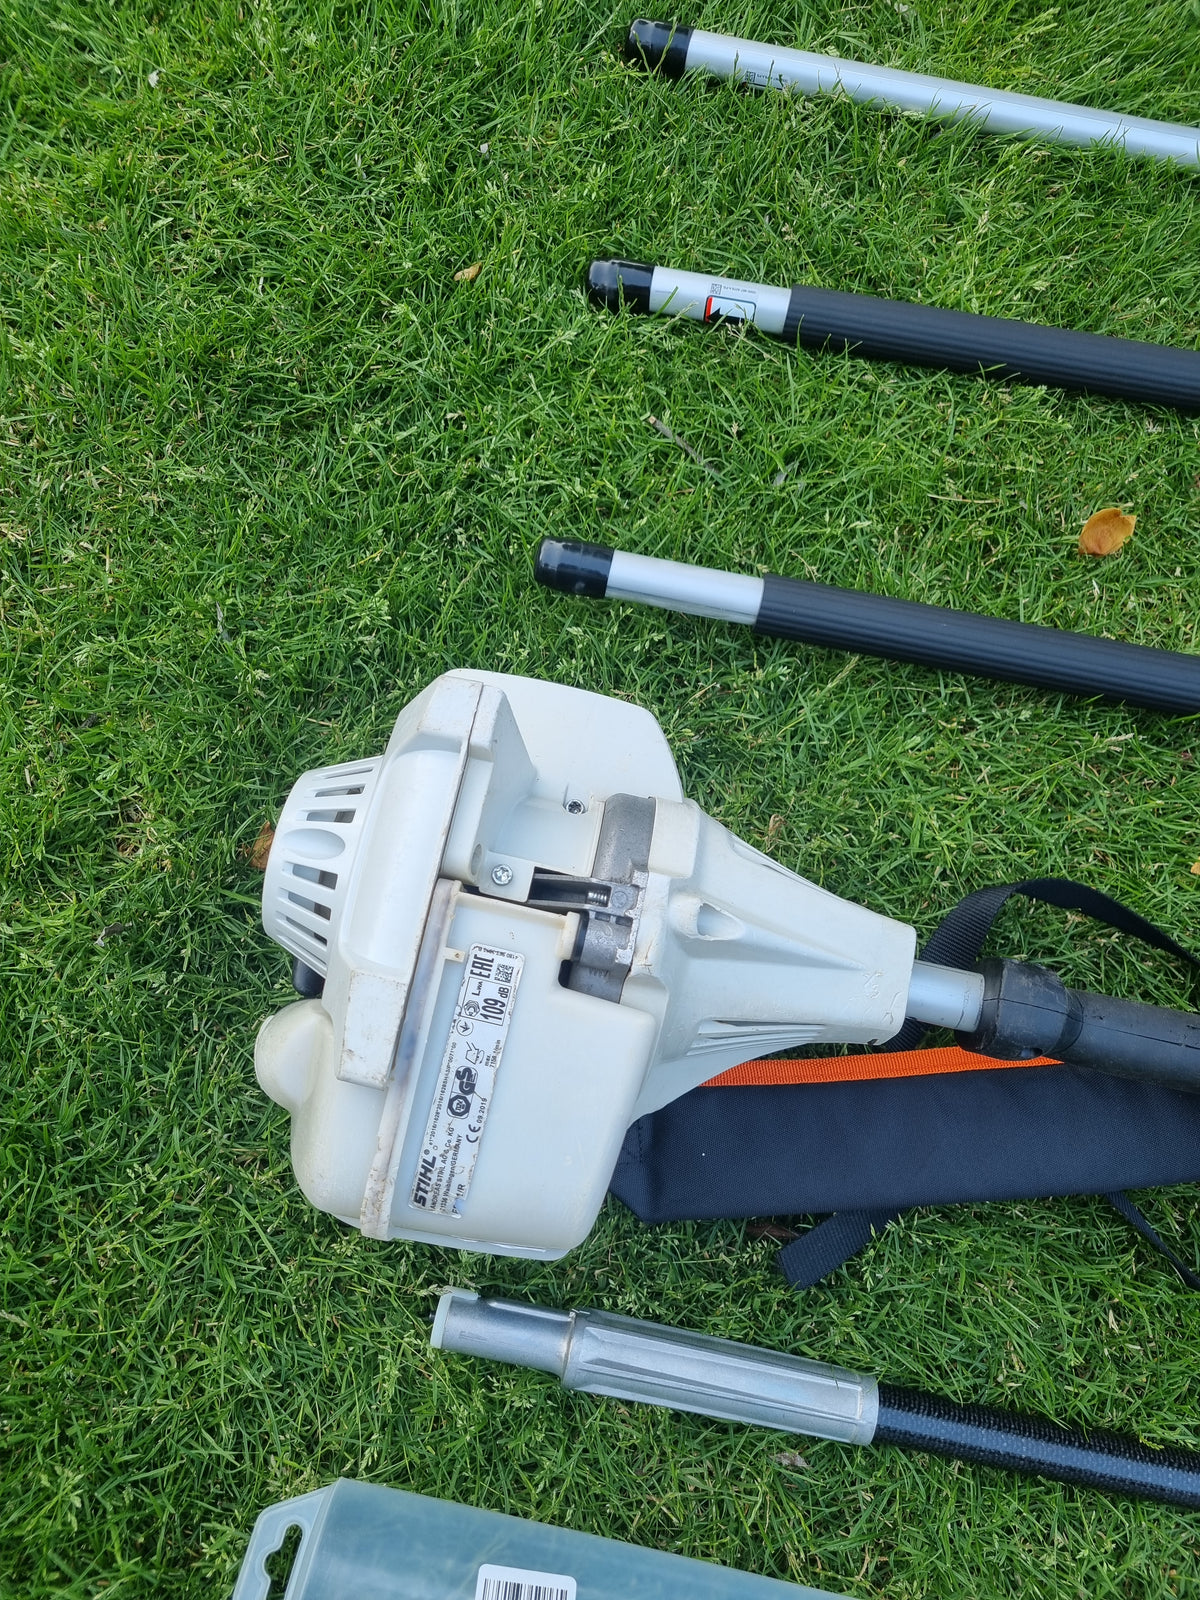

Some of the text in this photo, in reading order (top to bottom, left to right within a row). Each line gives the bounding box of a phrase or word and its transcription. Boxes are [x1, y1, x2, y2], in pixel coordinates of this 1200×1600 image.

[471, 954, 494, 978] EAC
[480, 987, 509, 1021] 109 dB
[477, 1097, 488, 1124] 09.2019
[413, 1156, 437, 1207] STIHL
[429, 1183, 442, 1210] ANDREAS
[436, 1165, 446, 1182] STIHL
[447, 1127, 455, 1137] KG
